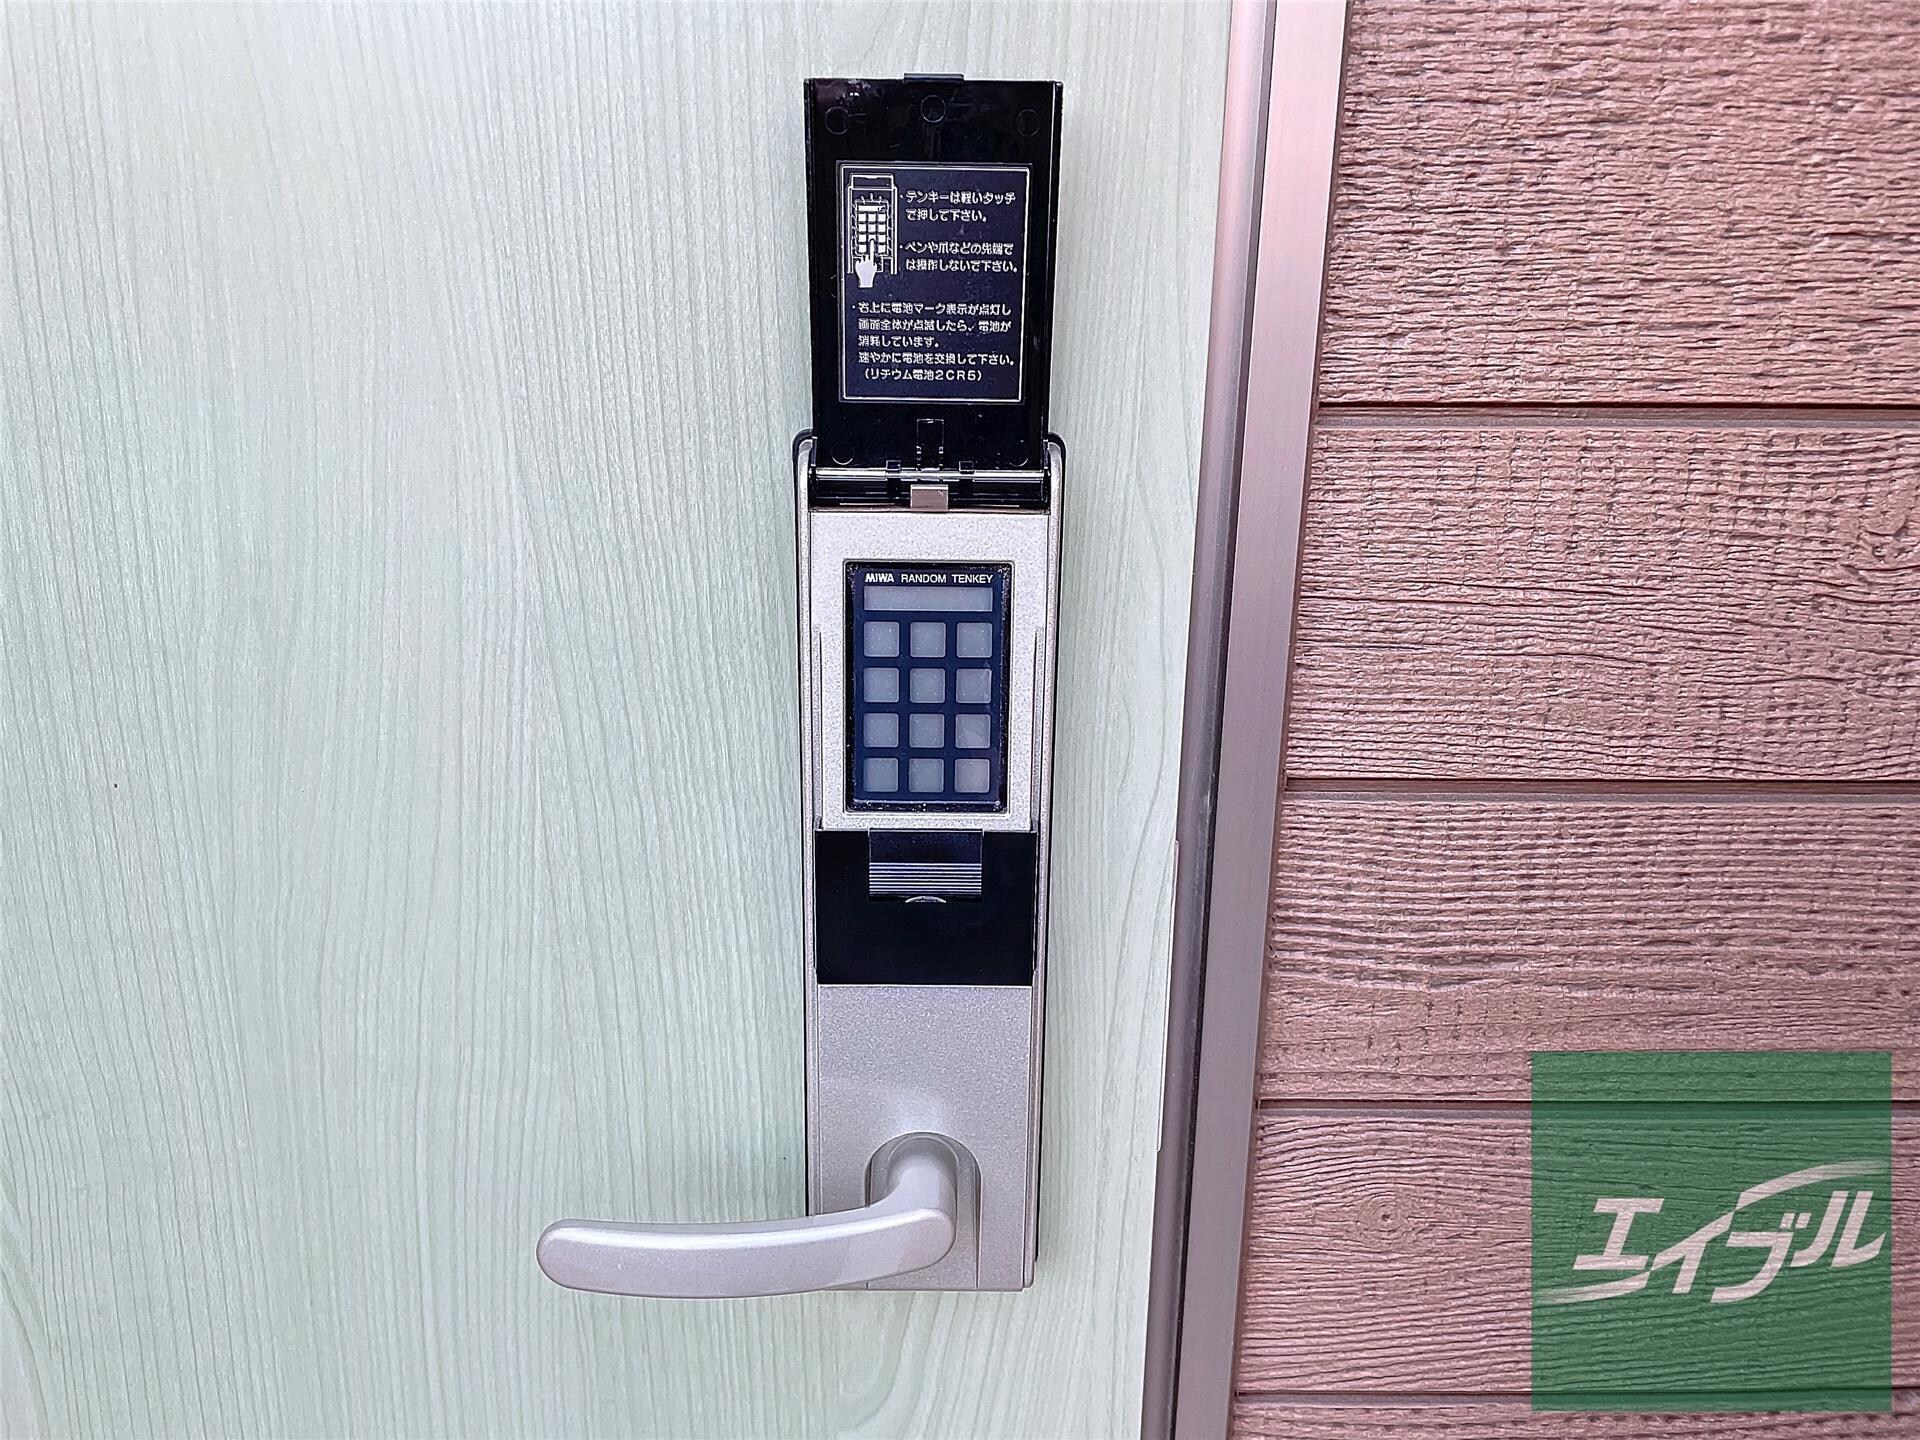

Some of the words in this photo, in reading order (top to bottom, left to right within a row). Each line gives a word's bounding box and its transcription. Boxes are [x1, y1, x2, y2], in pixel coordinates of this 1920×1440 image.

[905, 208, 987, 222] で押して下さい。
[906, 259, 1018, 273] は操作しないで下さい。
[858, 319, 1012, 332] 画面全体が点滅したら、電池が
[858, 335, 939, 348] 消耗しています。
[858, 352, 1015, 366] 速やかに電池を交換して下さい。
[865, 573, 894, 583] MIWA
[901, 574, 946, 583] RANDOM
[952, 574, 993, 583] TENKEY
